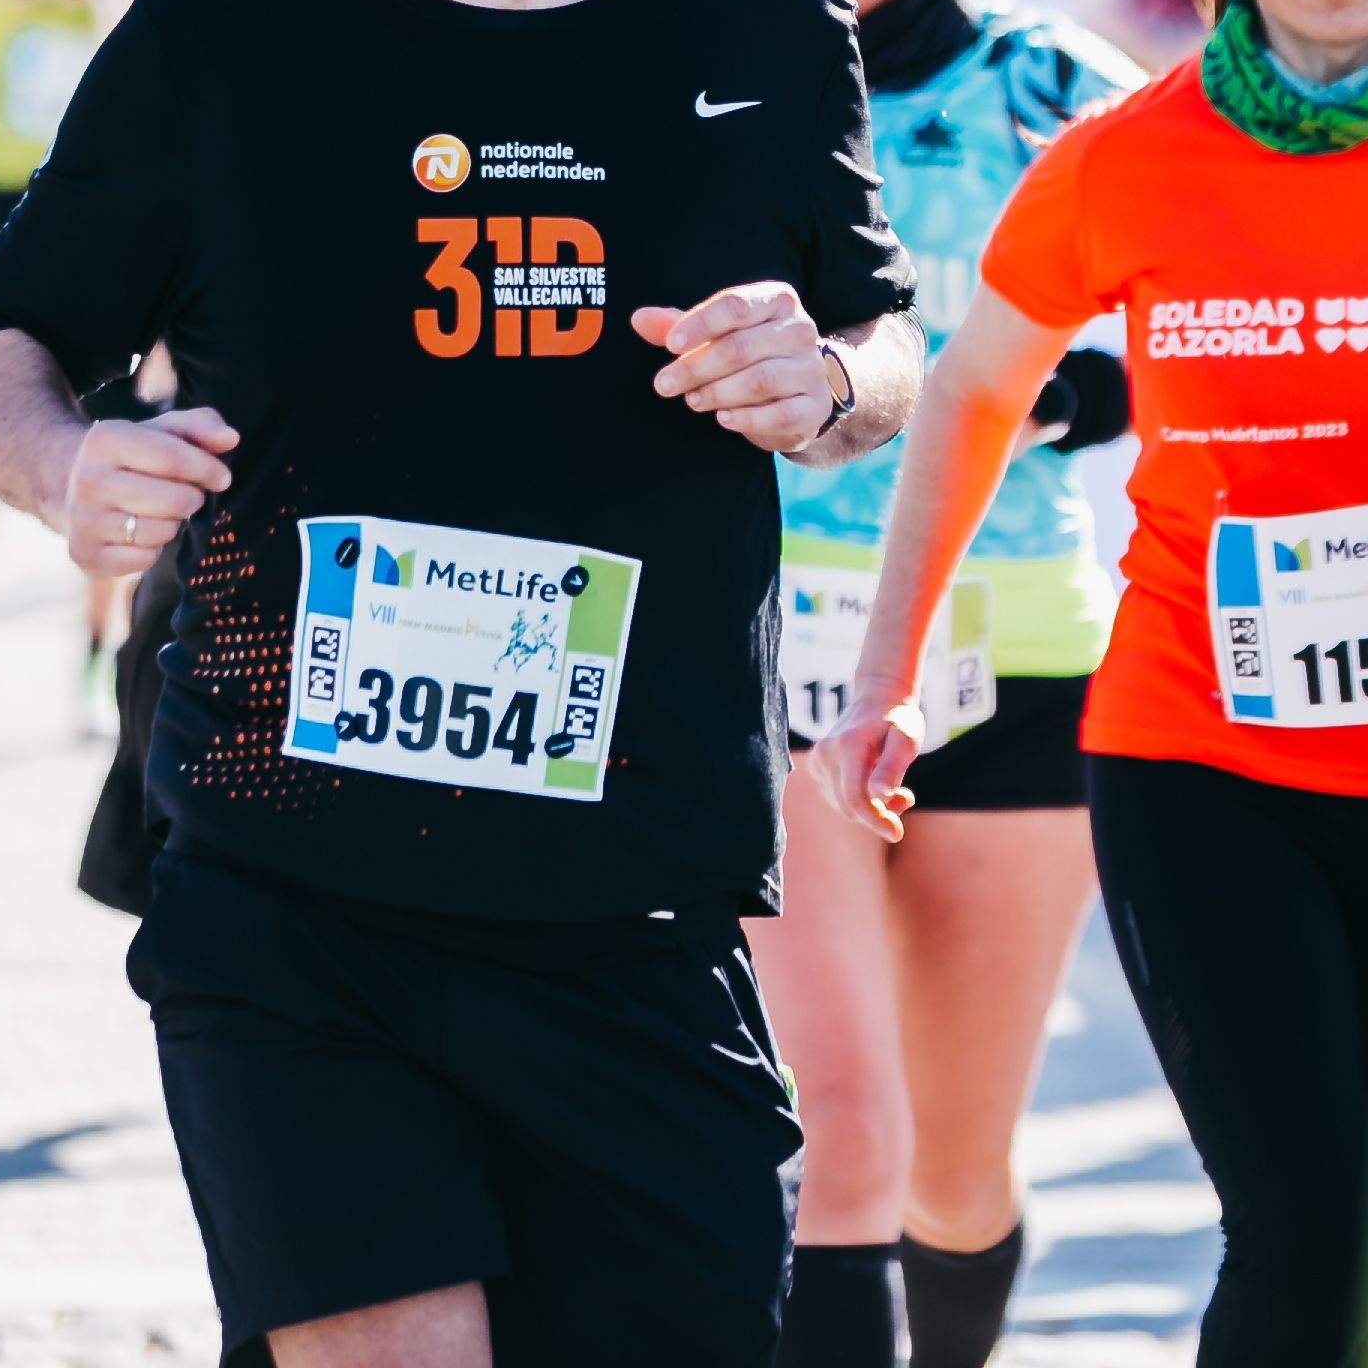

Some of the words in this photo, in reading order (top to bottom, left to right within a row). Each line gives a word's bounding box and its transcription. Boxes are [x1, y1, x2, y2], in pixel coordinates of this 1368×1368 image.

[481, 142, 574, 161] nationale
[481, 162, 606, 181] nederlanden
[415, 216, 605, 358] 31D
[493, 267, 525, 286] SAN
[529, 267, 606, 286] SILVESTRE
[493, 287, 583, 306] VALLECANA
[1148, 297, 1304, 331] SOLEDAD
[1147, 327, 1305, 359] CAZORLA
[426, 559, 559, 604] MetLife
[369, 602, 397, 625] VIII
[355, 669, 539, 767] 3954
